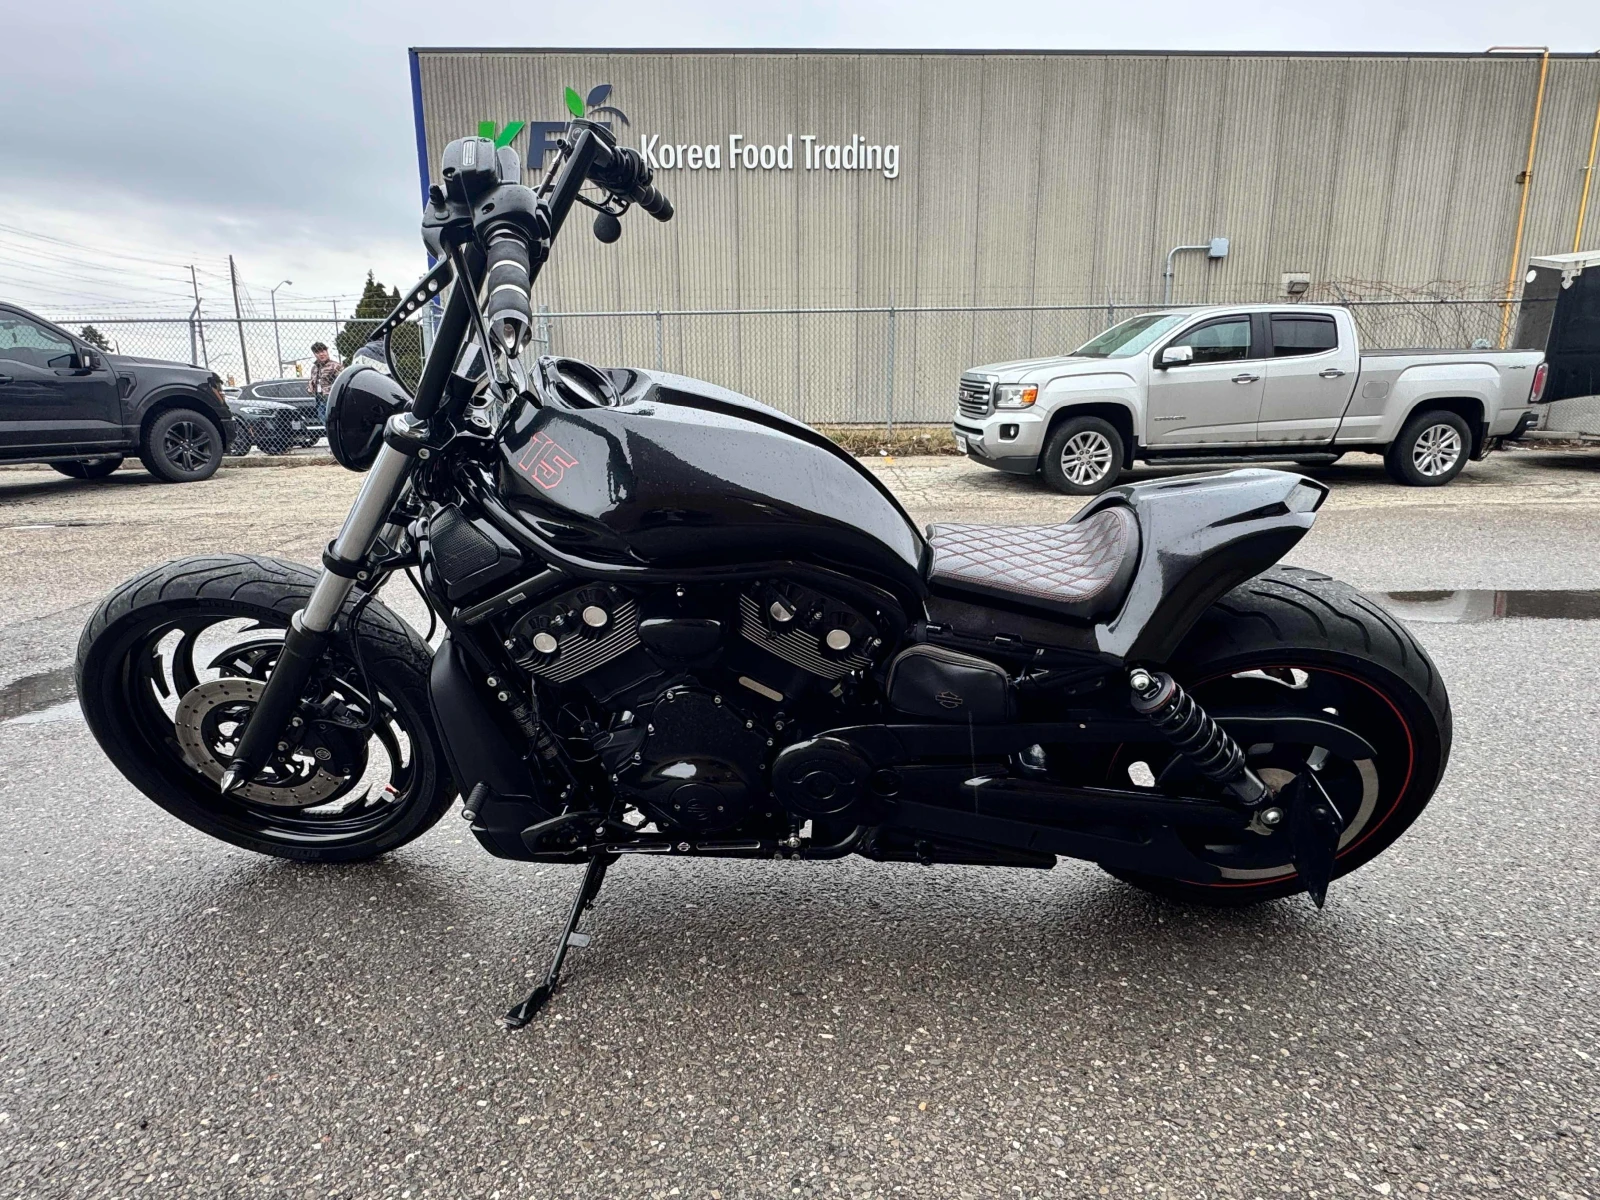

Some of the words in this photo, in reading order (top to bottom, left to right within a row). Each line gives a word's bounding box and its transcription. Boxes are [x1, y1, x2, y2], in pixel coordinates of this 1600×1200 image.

[640, 134, 721, 170] Korea
[729, 133, 793, 170] Food
[800, 134, 900, 179] Trading
